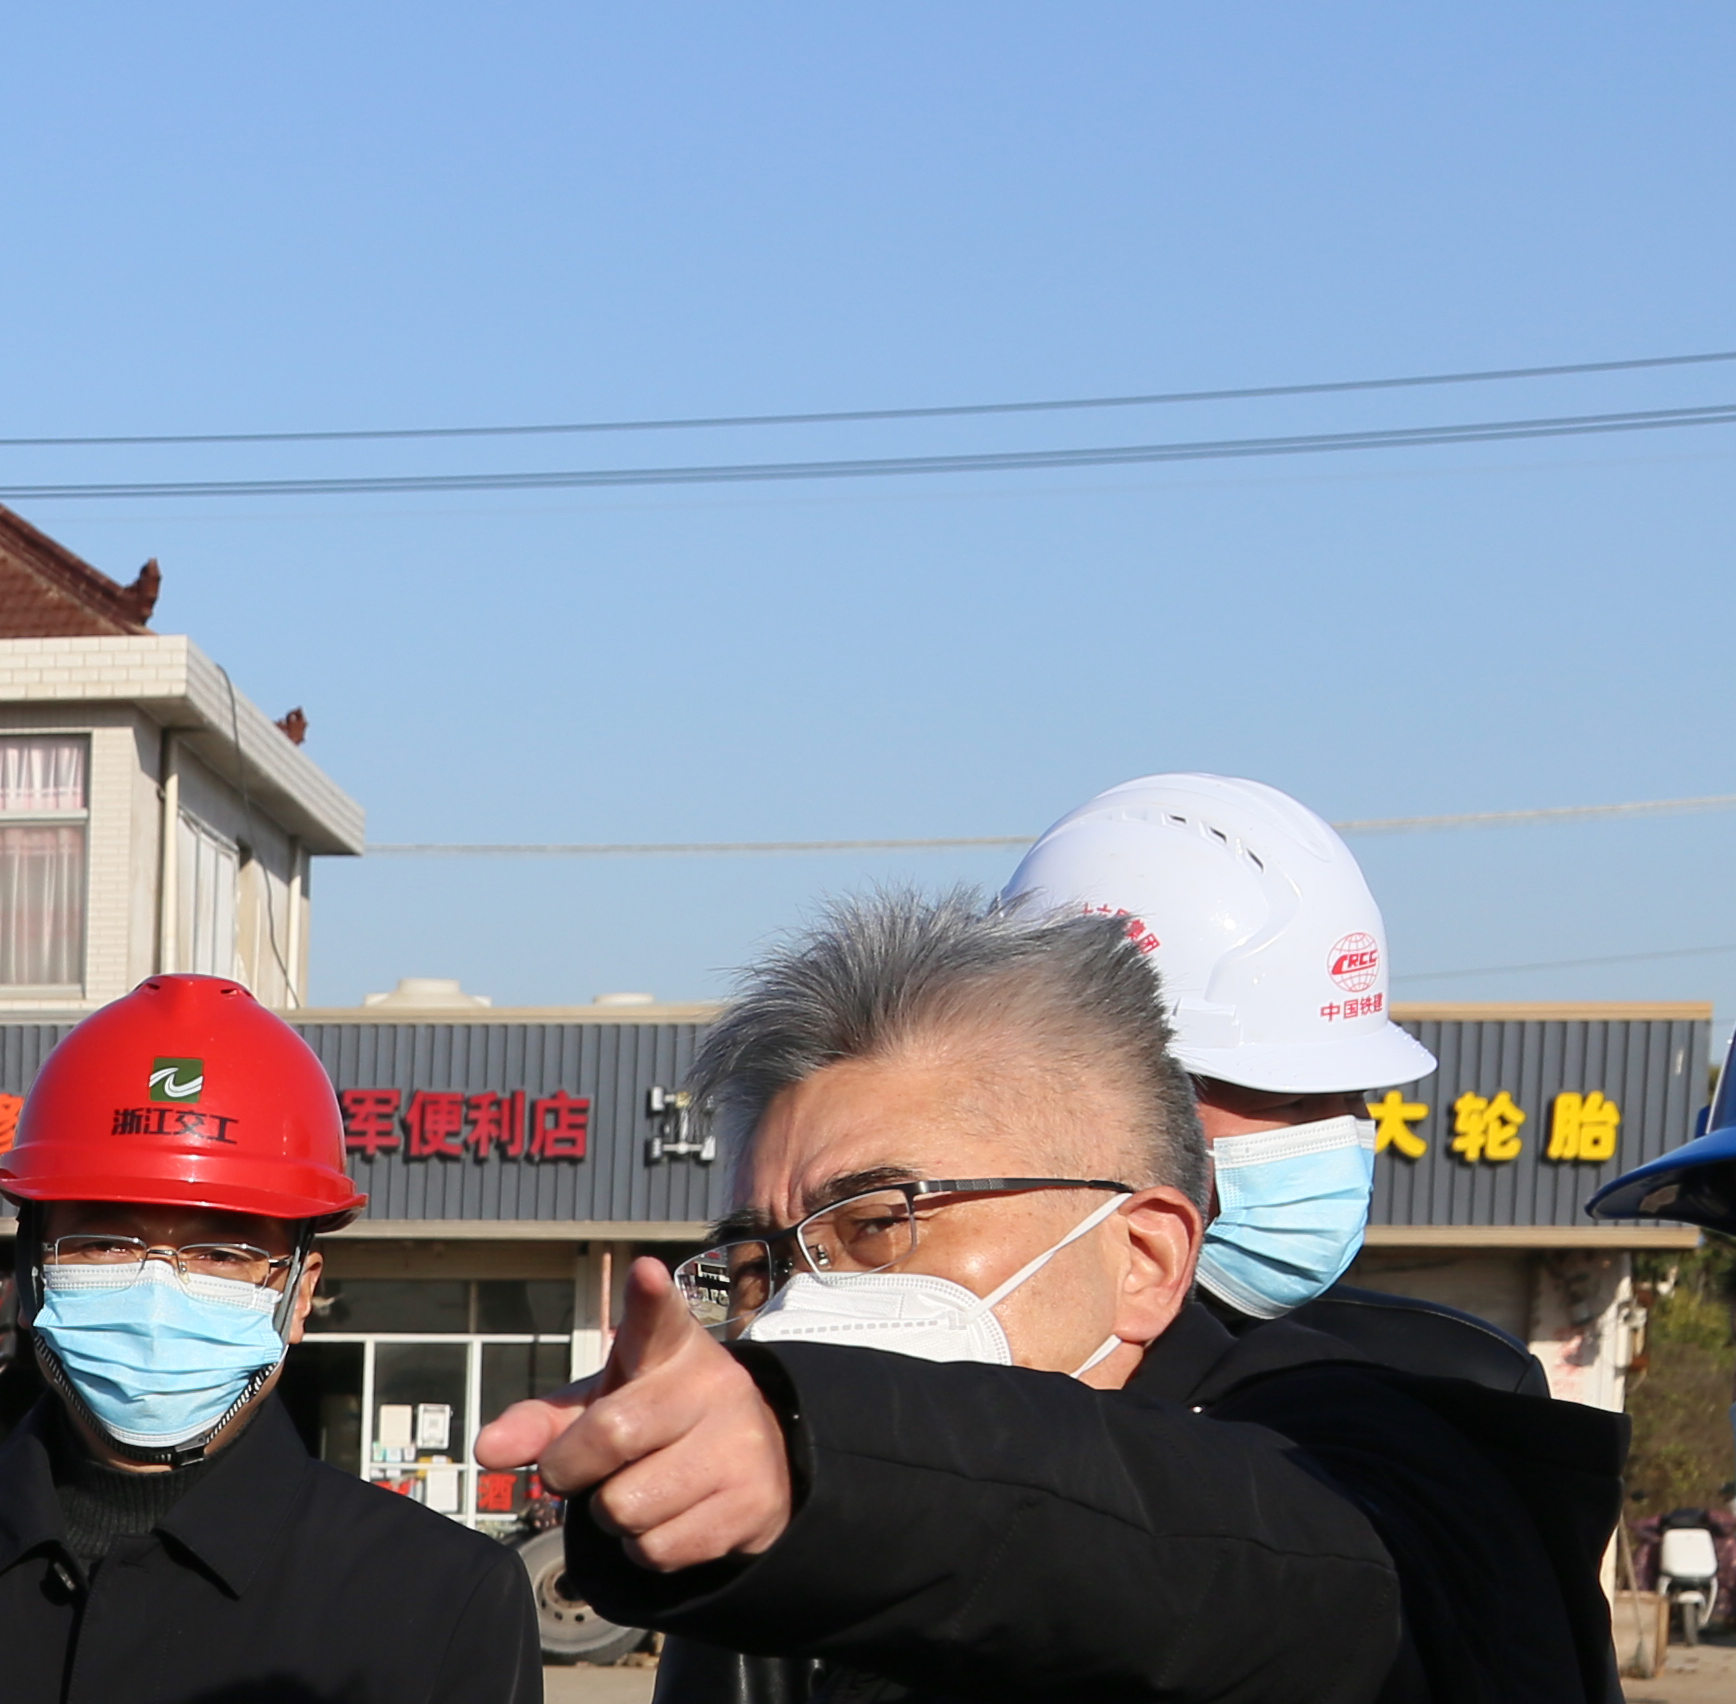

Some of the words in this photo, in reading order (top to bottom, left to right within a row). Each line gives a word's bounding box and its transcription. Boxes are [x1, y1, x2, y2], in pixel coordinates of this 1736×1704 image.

[1331, 948, 1379, 975] CRCC
[1319, 992, 1383, 1023] 中国铁建
[111, 1107, 239, 1145] 浙江交工
[342, 1088, 590, 1158] 军便利店
